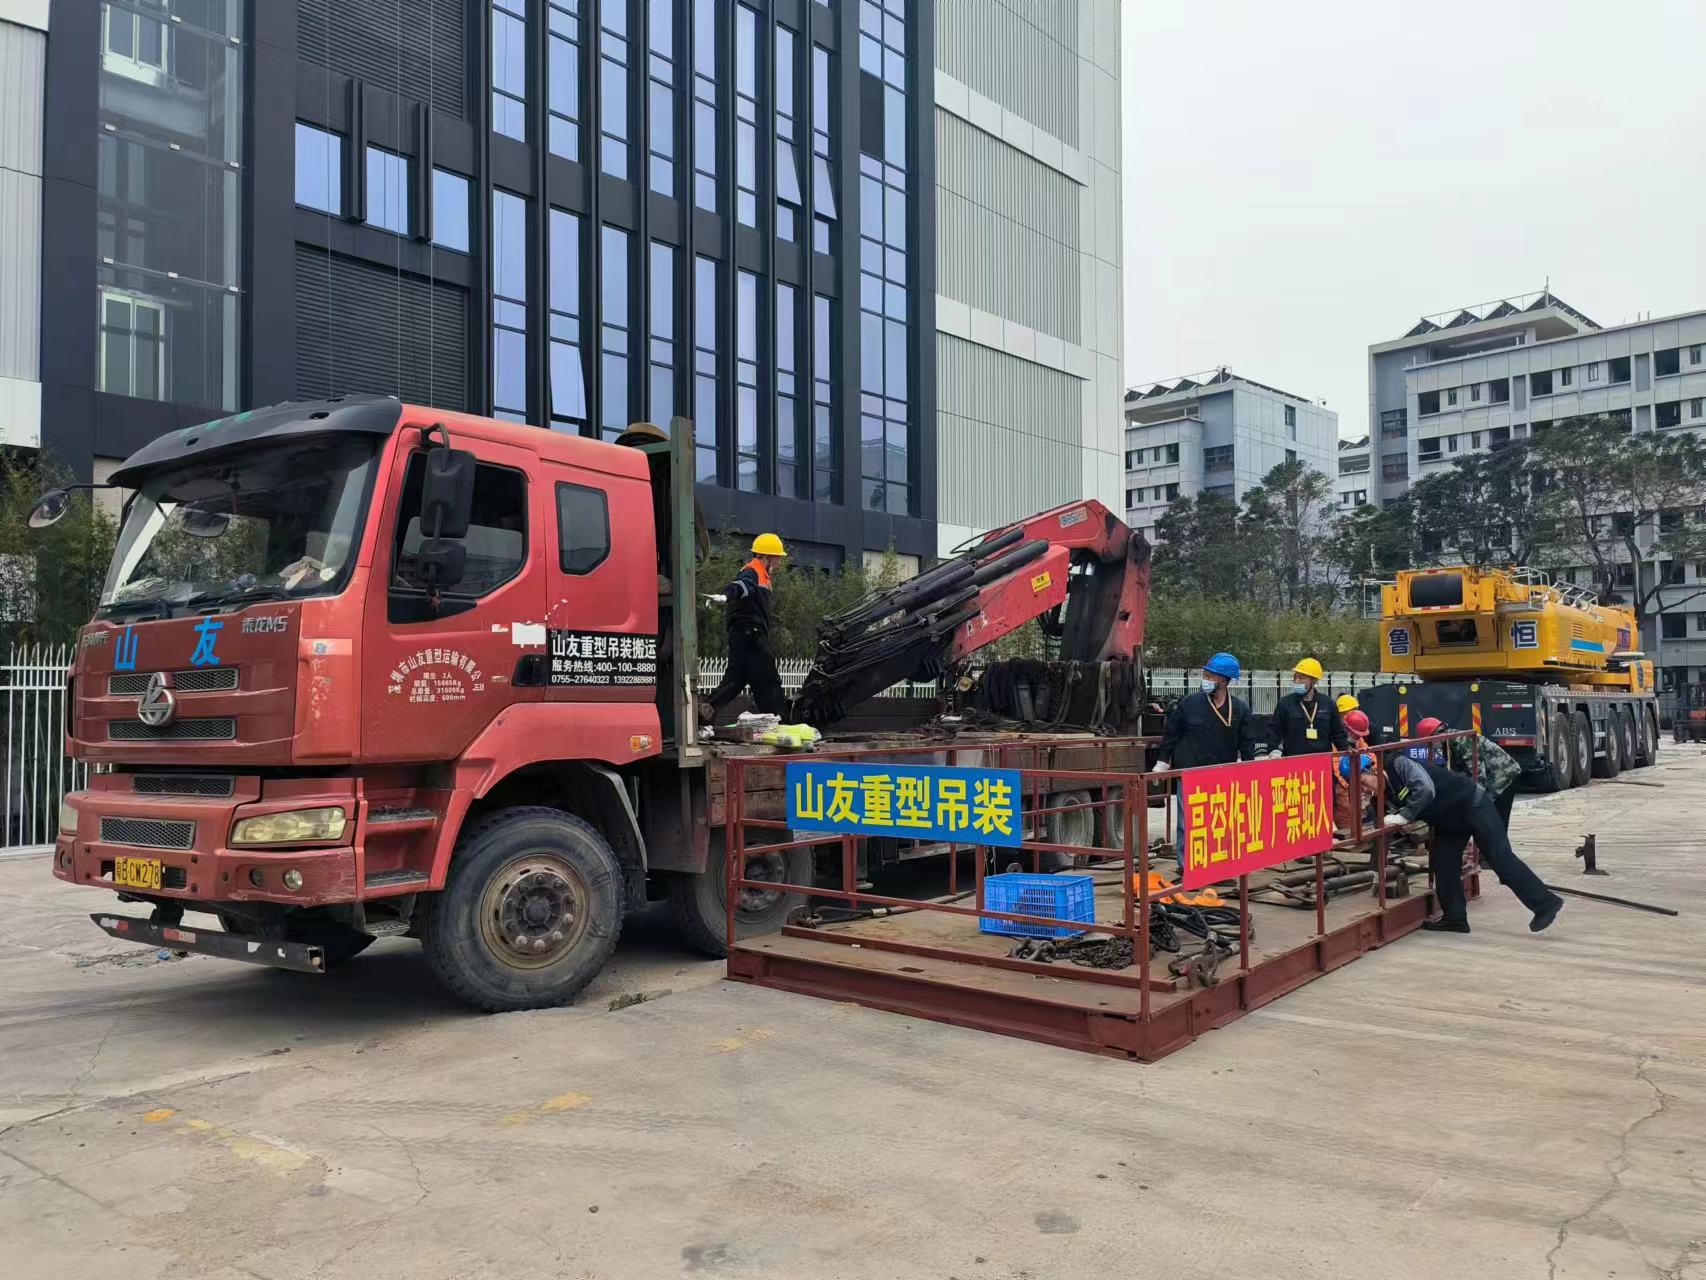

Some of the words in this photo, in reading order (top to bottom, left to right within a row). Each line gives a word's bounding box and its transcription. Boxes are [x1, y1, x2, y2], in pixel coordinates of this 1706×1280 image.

[552, 634, 656, 659] 山友重型吊装搬运
[795, 771, 1013, 836] 山友重型吊装
[1188, 779, 1264, 872] 高空作业
[1271, 769, 1331, 849] 严禁站人
